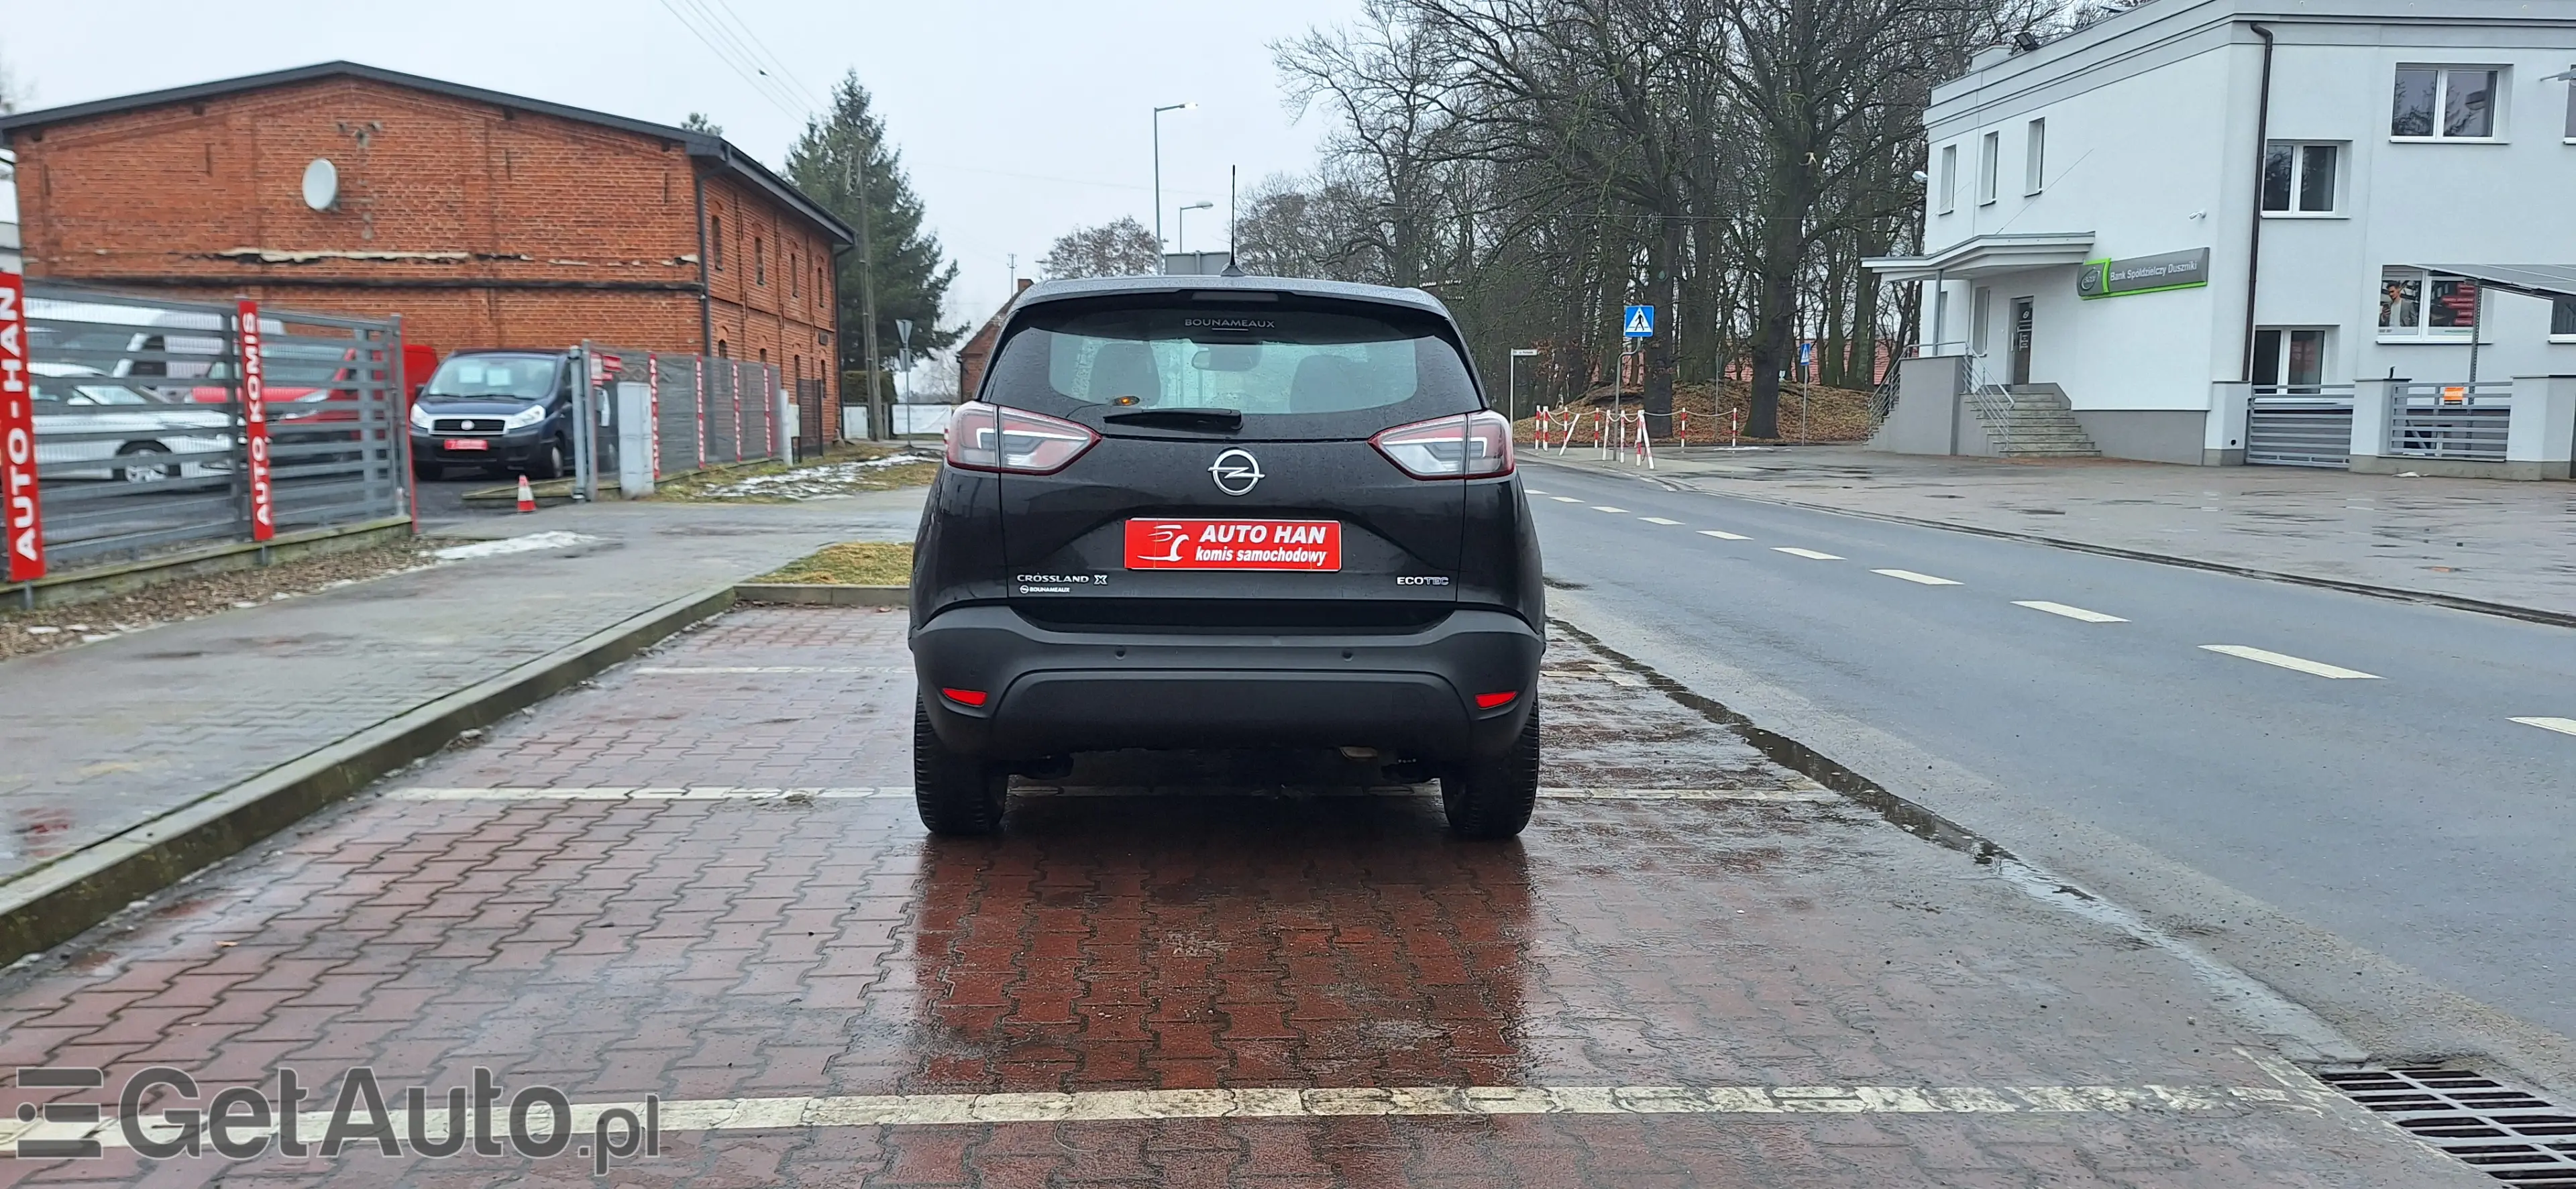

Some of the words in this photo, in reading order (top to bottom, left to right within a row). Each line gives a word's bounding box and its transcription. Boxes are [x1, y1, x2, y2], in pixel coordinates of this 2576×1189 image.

[2110, 271, 2126, 281] Bank
[2167, 261, 2197, 274] Duszniki
[1185, 319, 1275, 328] BOUNAMEAUX
[0, 286, 24, 392] HAN
[241, 312, 264, 424] KOMIS
[252, 436, 271, 526] AUTO
[7, 427, 38, 562] AUTO
[1199, 524, 1267, 543] AUTO
[1273, 526, 1327, 545] HAN
[1195, 545, 1233, 562] komis
[1236, 546, 1328, 567] samochodowy
[1016, 574, 1089, 583] CROSSLAND
[1093, 575, 1108, 585] X
[1397, 576, 1449, 585] ECOTEC
